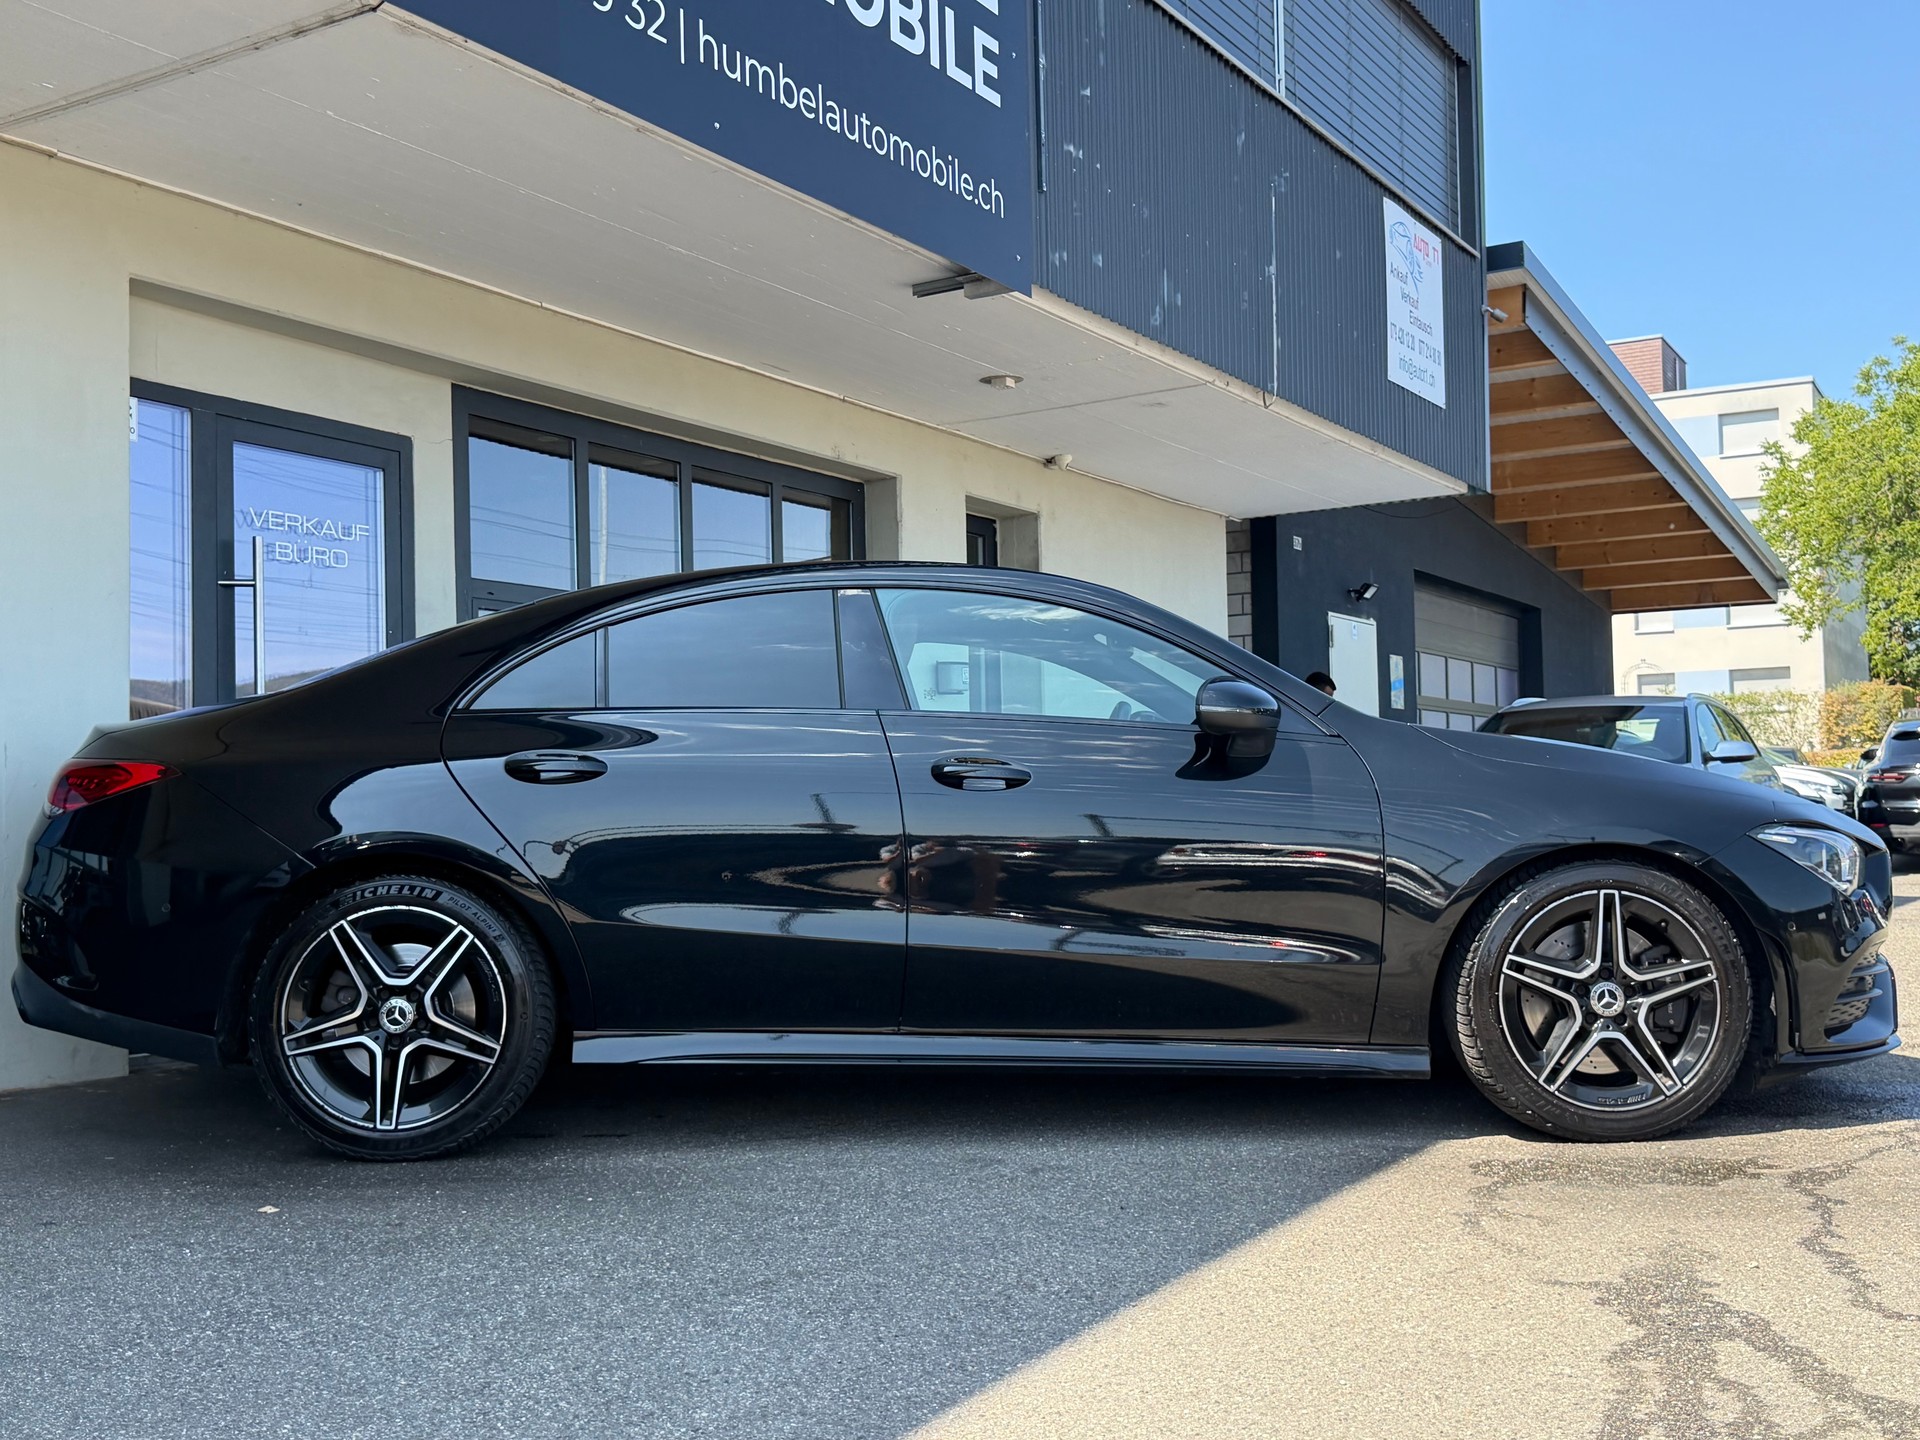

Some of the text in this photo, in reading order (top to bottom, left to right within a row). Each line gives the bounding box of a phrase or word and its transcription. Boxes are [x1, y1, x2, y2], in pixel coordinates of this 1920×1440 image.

[699, 18, 1005, 218] humbelautomobile.ch
[1413, 233, 1430, 261] AUTO
[1390, 261, 1409, 286] Ankauf
[1400, 285, 1420, 311] Verkauf
[1409, 309, 1433, 337] Eintausch
[249, 507, 370, 541] VERKAUF
[275, 539, 349, 568] BÜRO
[447, 895, 472, 912] PILOT
